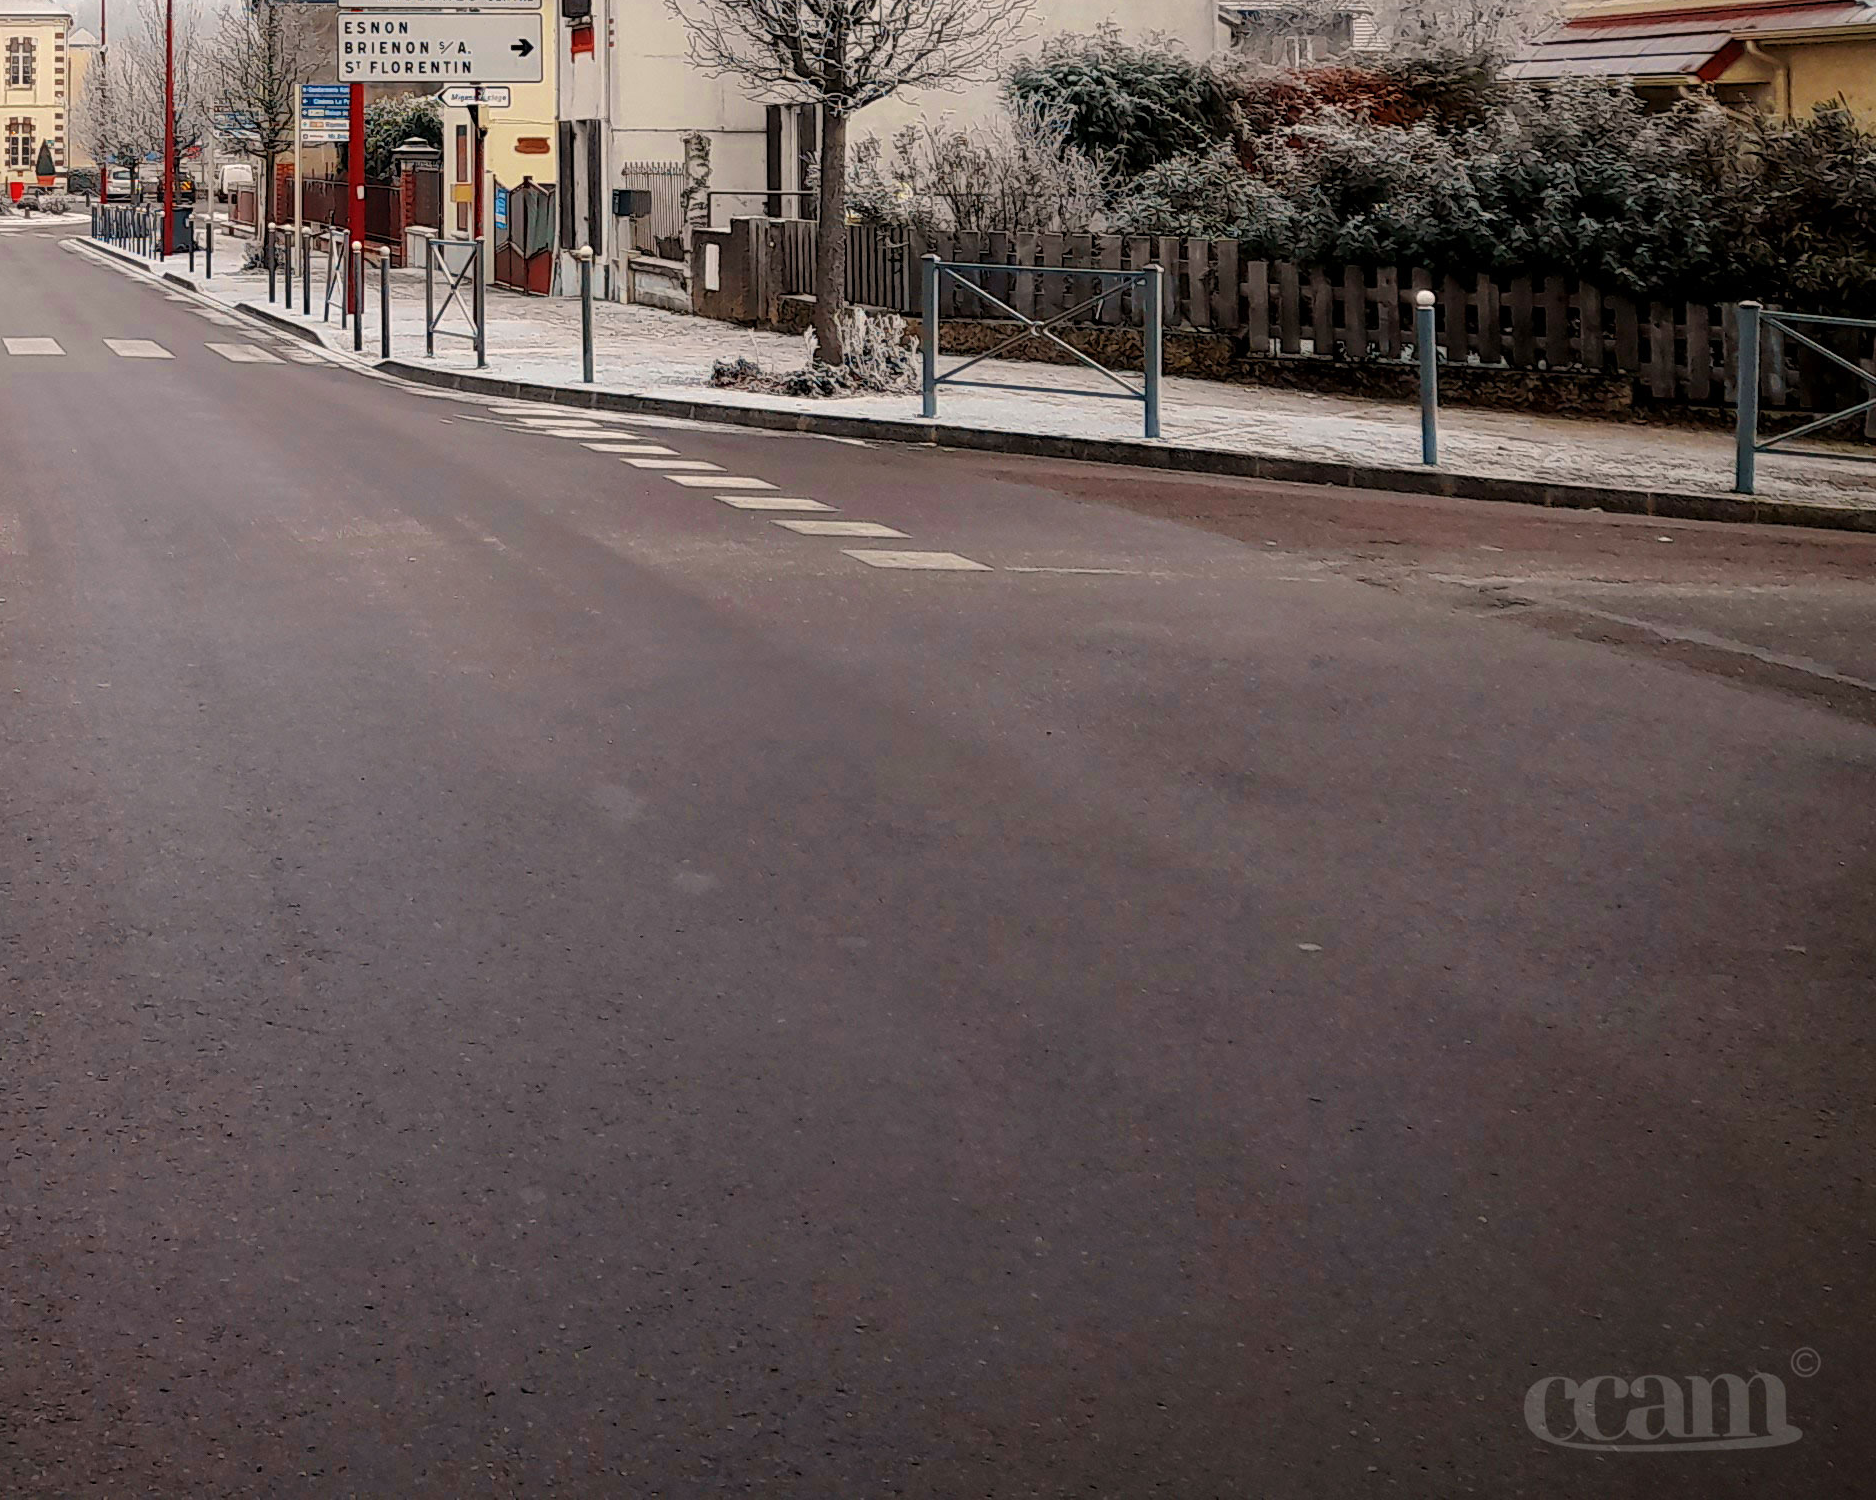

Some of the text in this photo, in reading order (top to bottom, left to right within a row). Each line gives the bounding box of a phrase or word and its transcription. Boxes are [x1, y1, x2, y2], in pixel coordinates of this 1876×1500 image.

[344, 21, 409, 34] ESNON
[344, 41, 430, 55] BRIENON
[370, 61, 472, 74] FLORENTIN
